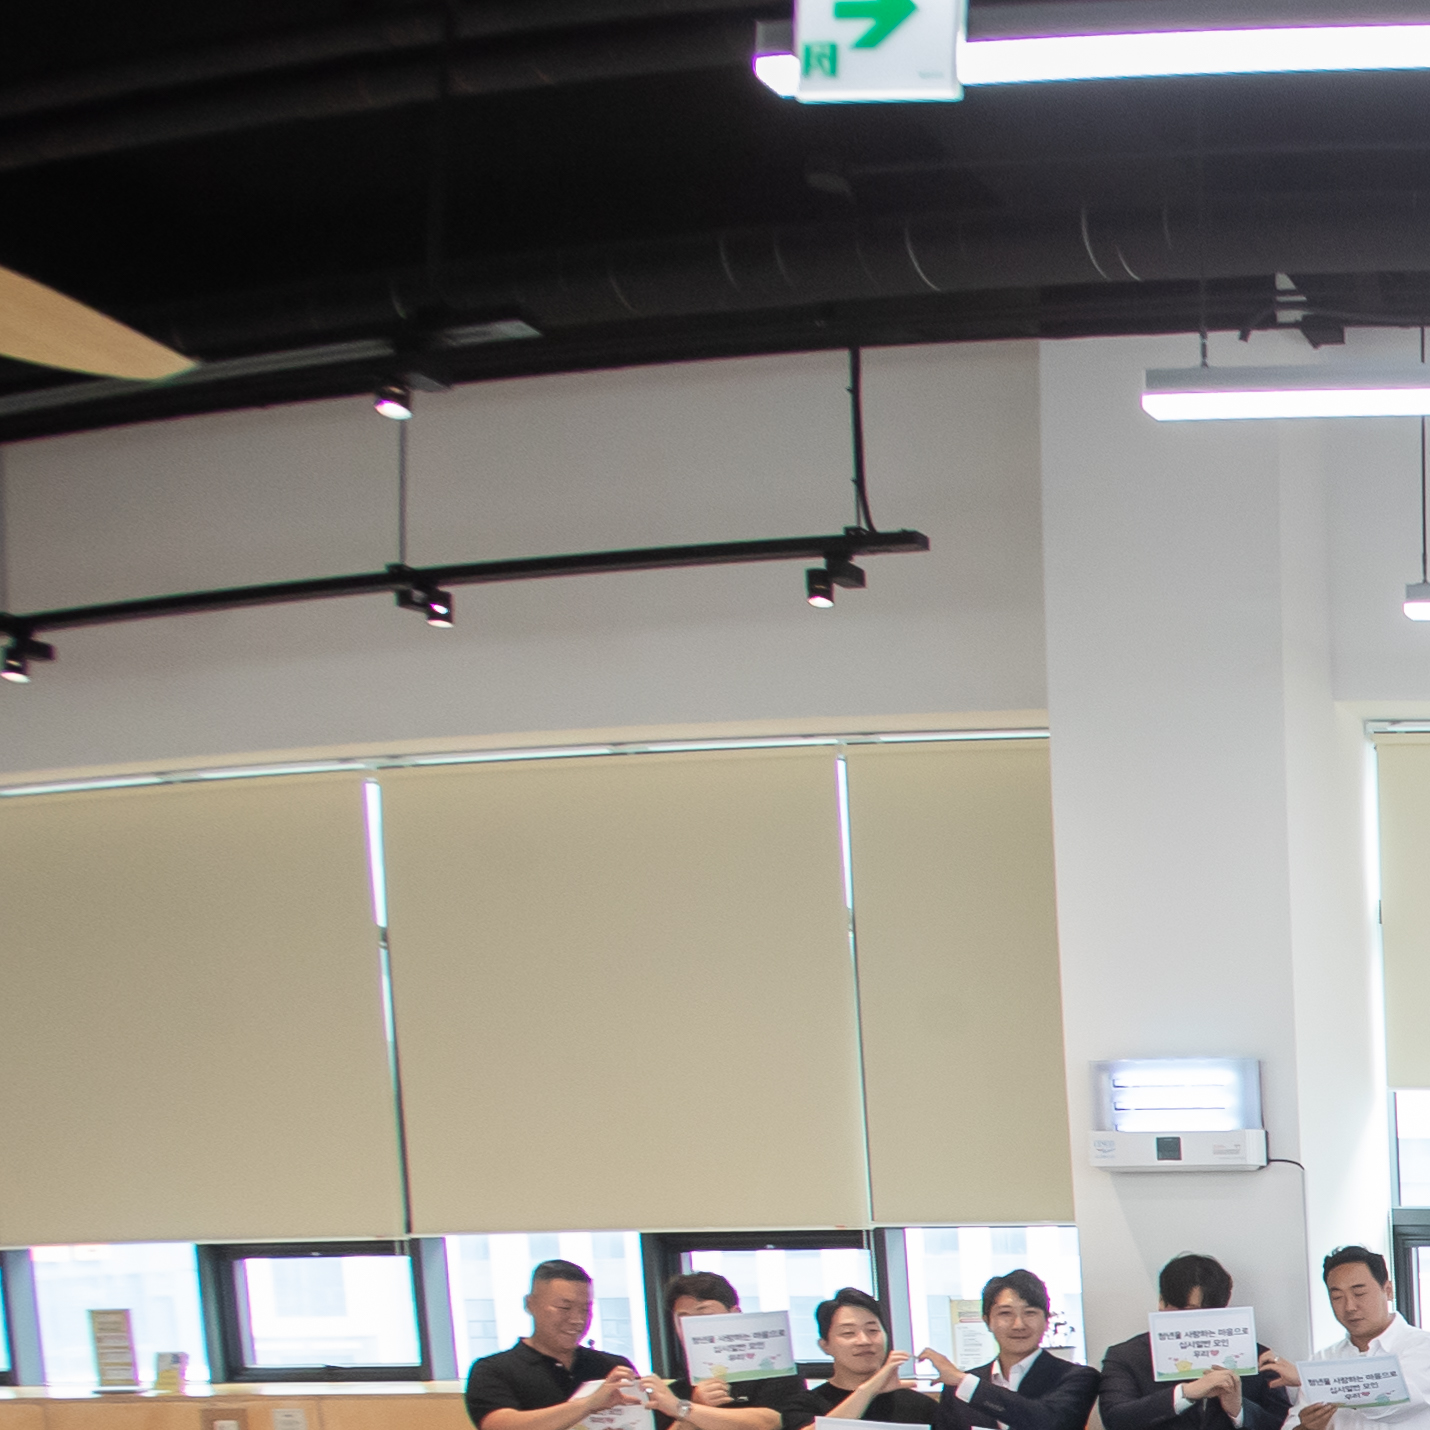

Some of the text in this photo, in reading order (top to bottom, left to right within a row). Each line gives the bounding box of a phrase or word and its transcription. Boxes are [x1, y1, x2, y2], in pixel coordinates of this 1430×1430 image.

[1158, 1328, 1248, 1340] 청년을 사랑하는 마음으로
[1180, 1339, 1228, 1349] 십시일반 모인
